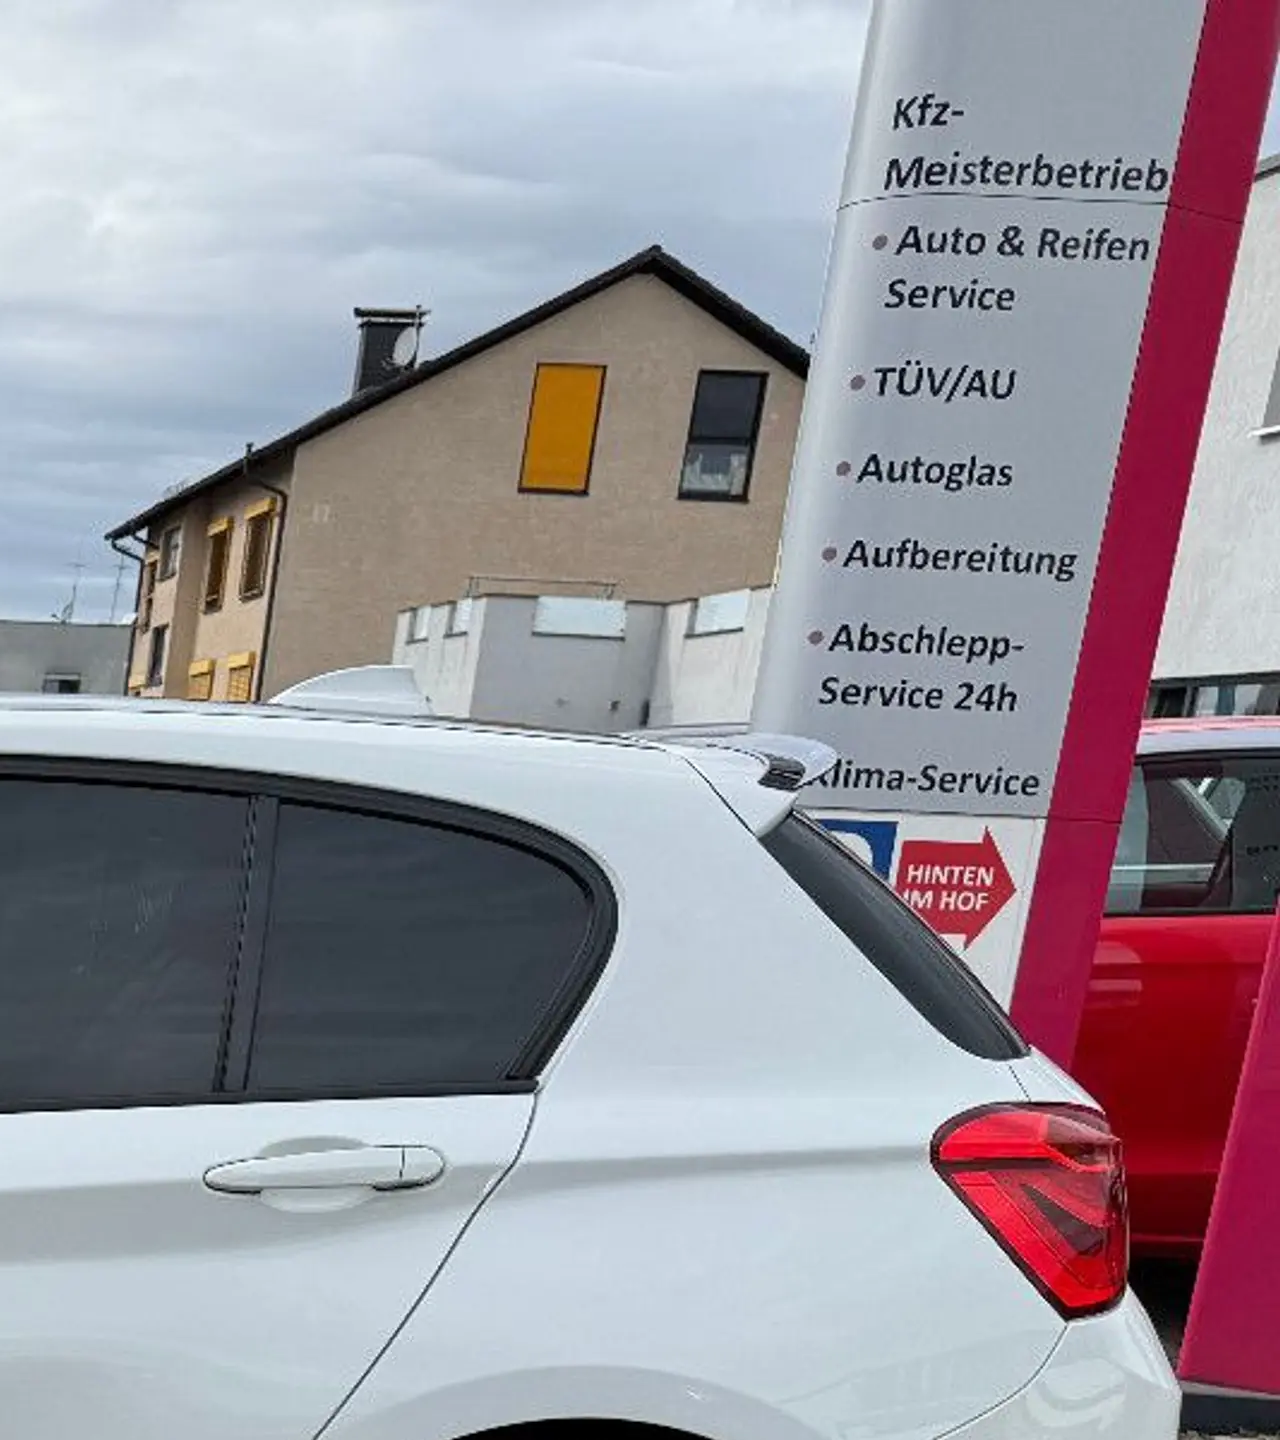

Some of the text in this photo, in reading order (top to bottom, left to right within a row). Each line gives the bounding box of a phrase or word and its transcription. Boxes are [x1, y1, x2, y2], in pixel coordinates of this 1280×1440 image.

[892, 93, 965, 131] Kfz-
[883, 151, 1170, 193] Meisterbetrieb
[894, 225, 1151, 262] Auto & Reifen
[883, 278, 1016, 313] Service
[873, 360, 1018, 403] TÜV/AU
[856, 453, 1014, 493] Autoglas
[841, 538, 1079, 583] Aufbereitung
[827, 623, 1025, 665] Abschlepp-
[818, 676, 1019, 713] Service 24h
[907, 863, 996, 887] HINTEN
[939, 890, 990, 912] HOF
